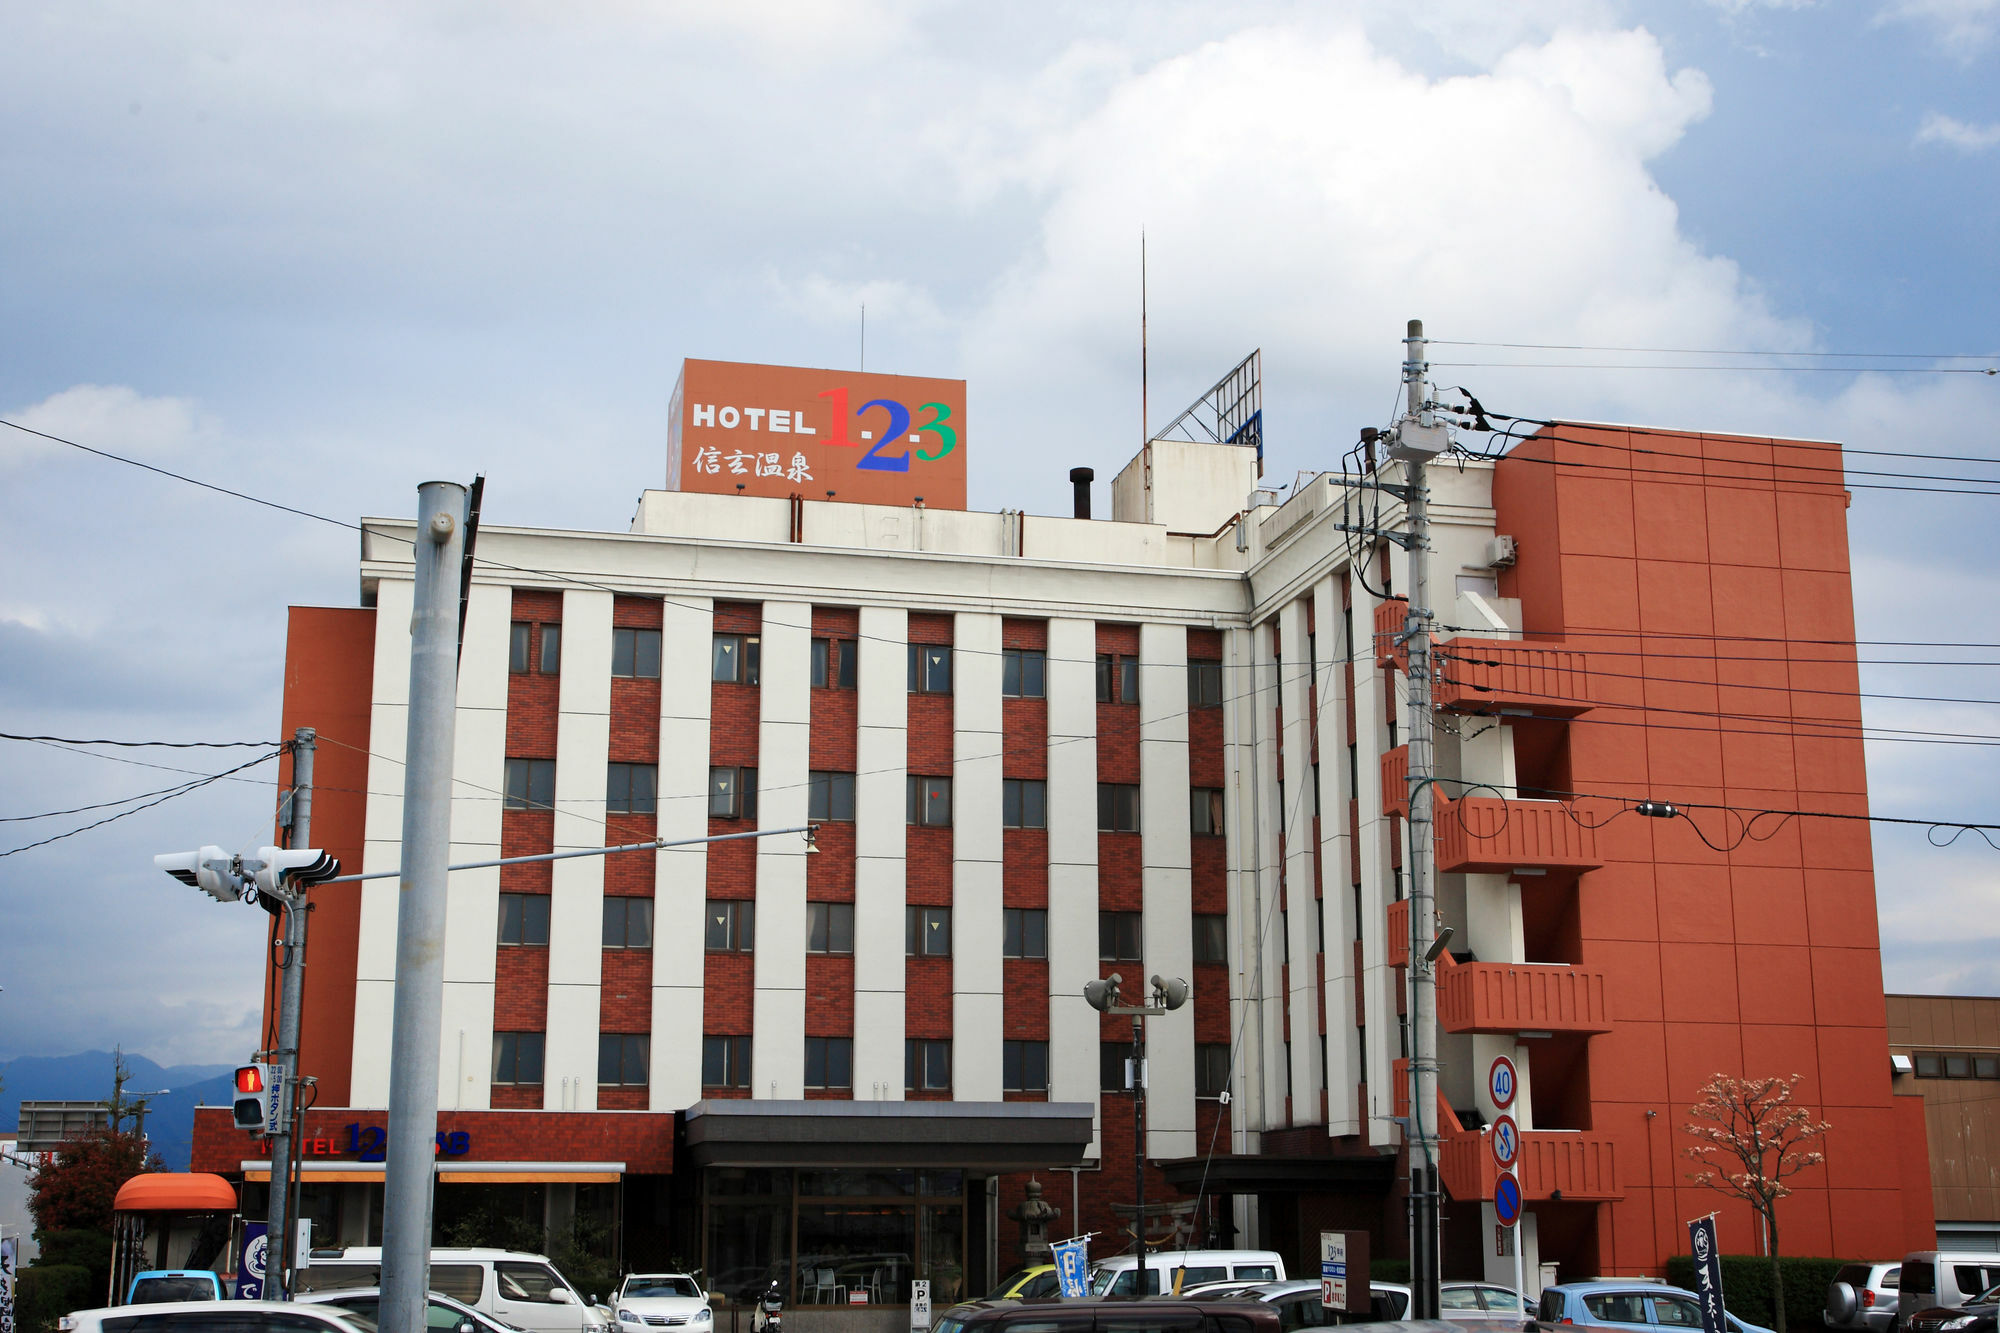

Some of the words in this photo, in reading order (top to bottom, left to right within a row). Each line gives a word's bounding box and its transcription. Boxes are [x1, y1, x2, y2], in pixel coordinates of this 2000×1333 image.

[692, 403, 816, 435] HOTEL
[692, 445, 814, 484] 信玄温泉
[1495, 1071, 1510, 1095] 40
[269, 1084, 280, 1131] 押ボタン式
[261, 1138, 341, 1155] HTEL
[917, 1290, 925, 1300] P
[1324, 1283, 1330, 1301] P
